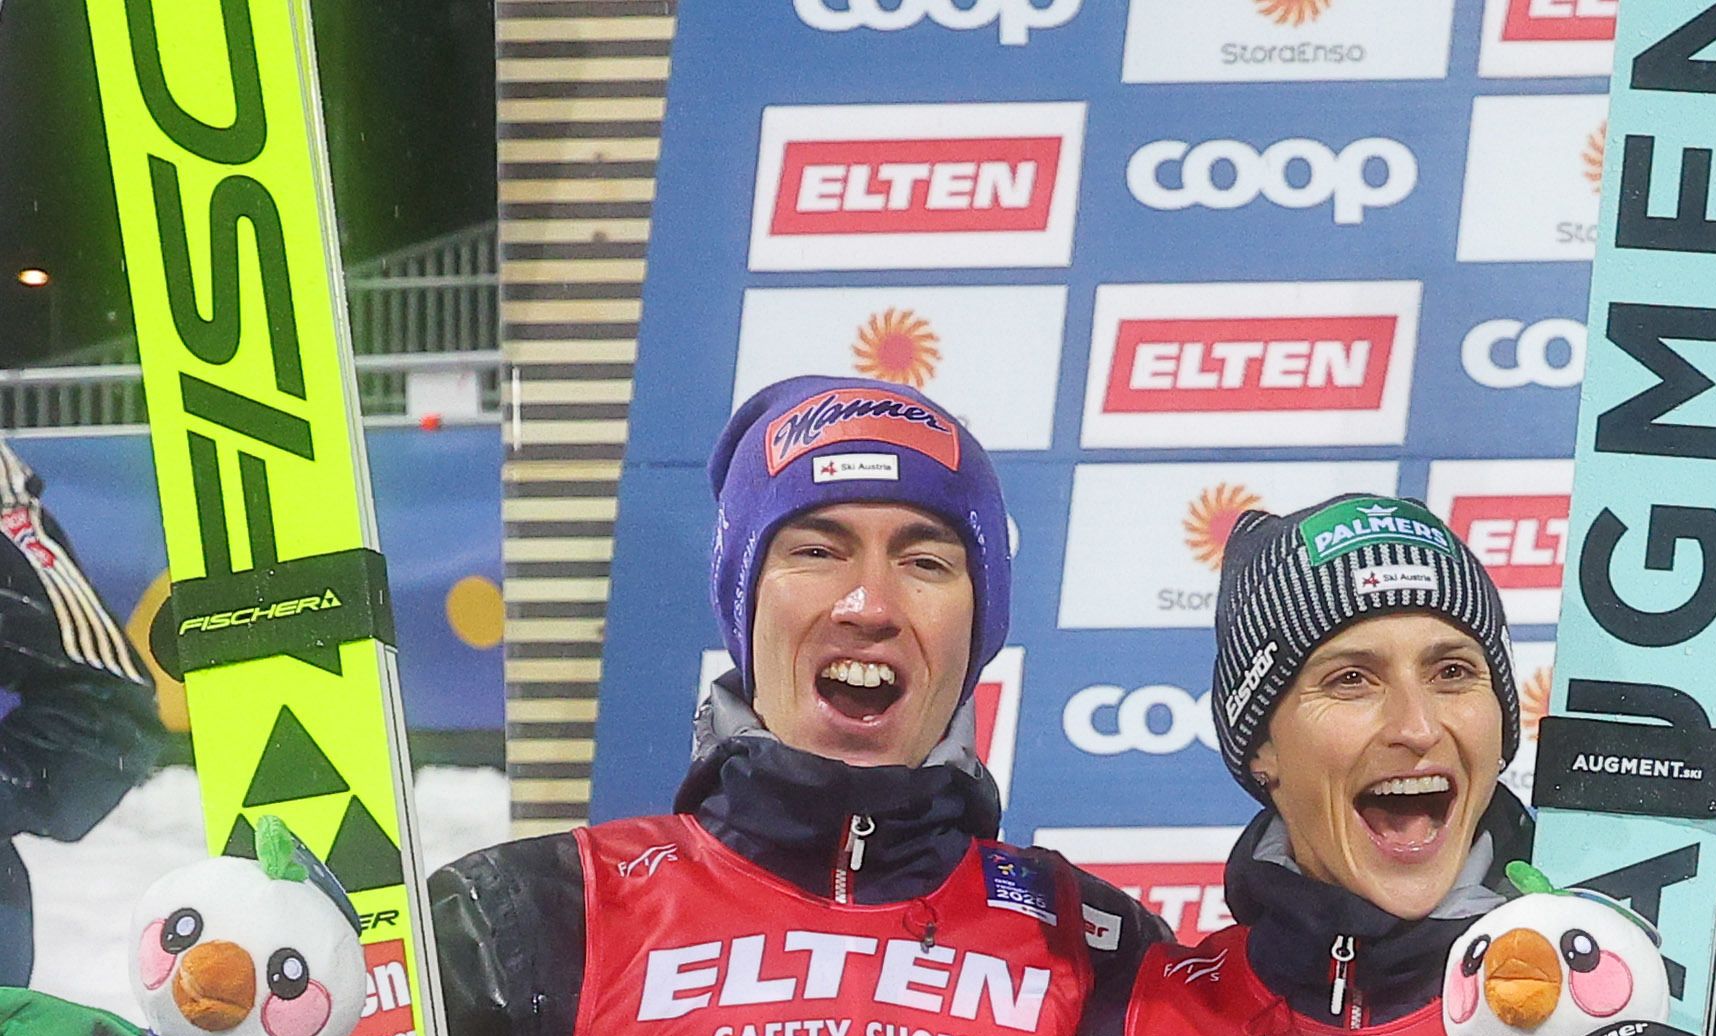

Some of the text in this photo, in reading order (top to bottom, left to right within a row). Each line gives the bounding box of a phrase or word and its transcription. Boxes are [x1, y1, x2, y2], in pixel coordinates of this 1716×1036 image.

[1220, 42, 1364, 64] StoraEnso
[795, 161, 1037, 212] ELTEN
[1126, 138, 1418, 225] coop
[1129, 340, 1373, 391] ELTEN
[1461, 318, 1588, 390] co
[773, 394, 952, 460] Manner
[841, 462, 892, 472] Ski Austria
[1314, 516, 1447, 553] PALMERS
[1383, 573, 1431, 583] Ski Austria
[179, 593, 322, 636] FISCHER
[1225, 641, 1278, 727] Eisbär
[1062, 684, 1219, 755] co
[637, 929, 1051, 1032] ELTEN
